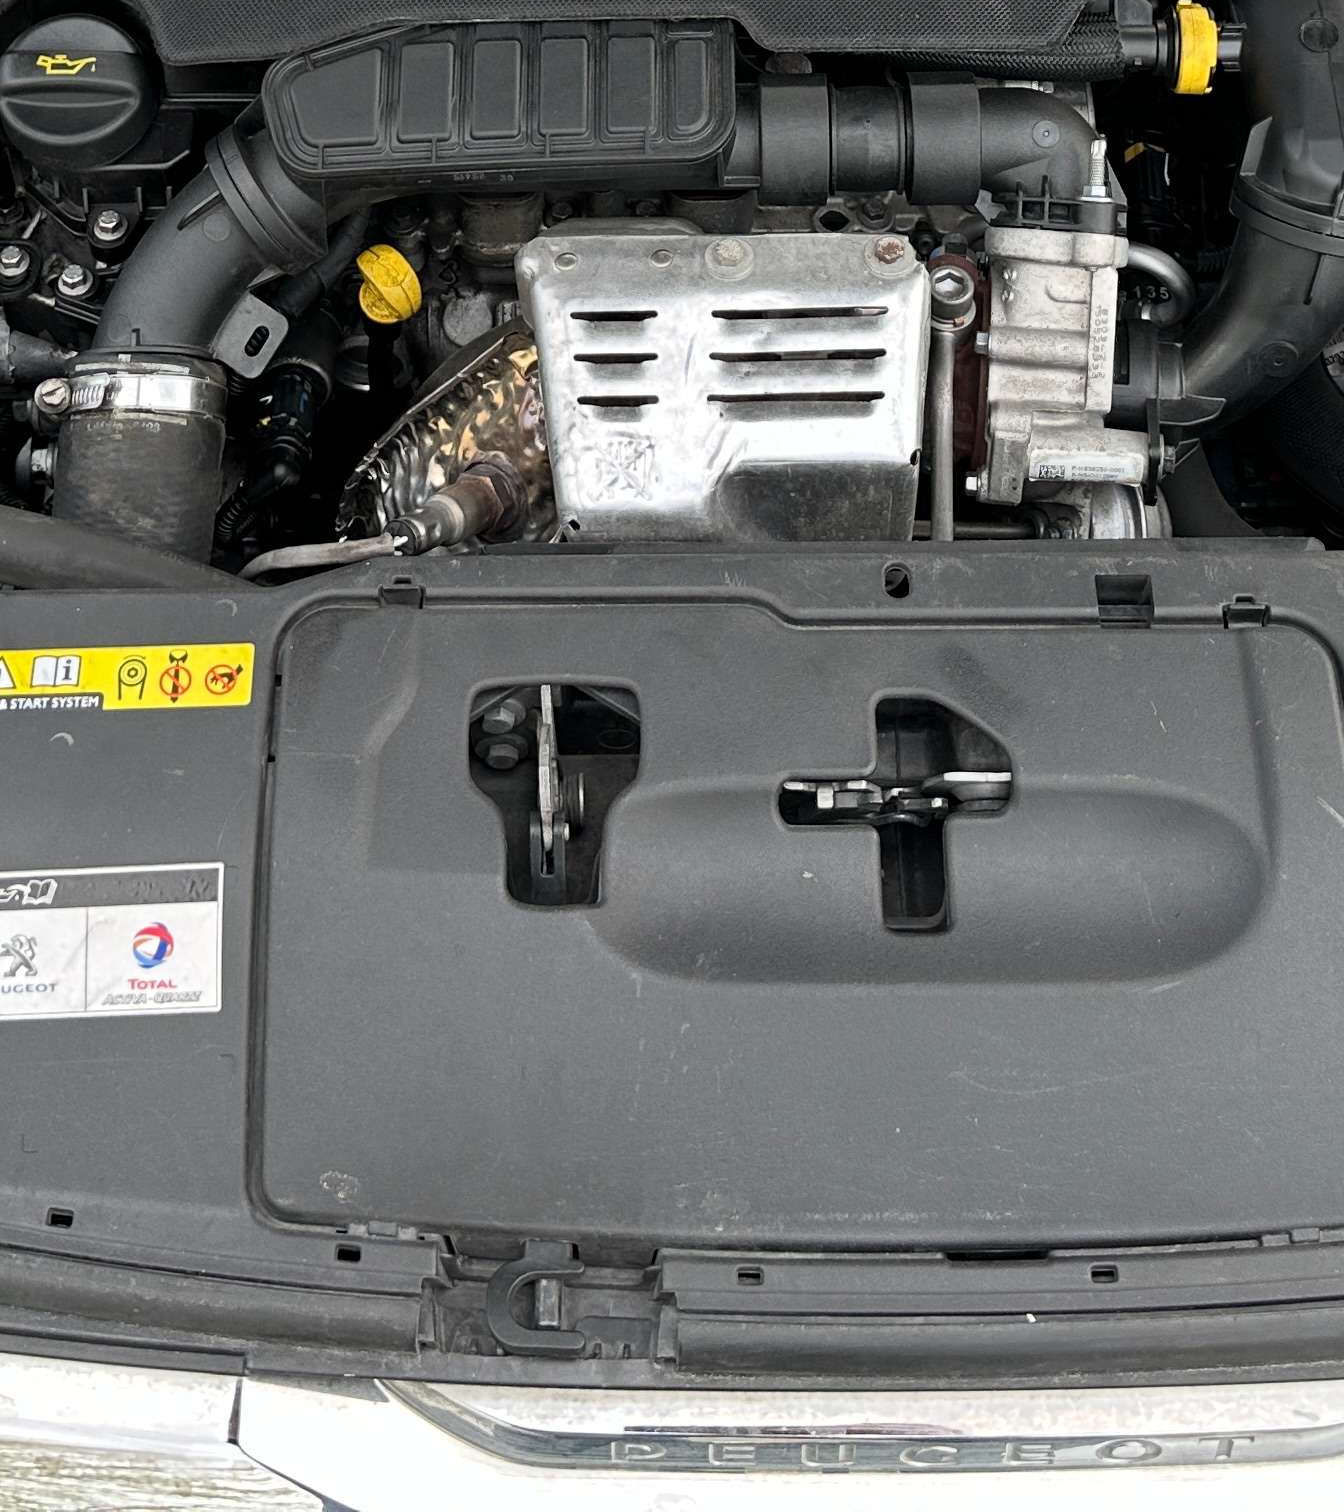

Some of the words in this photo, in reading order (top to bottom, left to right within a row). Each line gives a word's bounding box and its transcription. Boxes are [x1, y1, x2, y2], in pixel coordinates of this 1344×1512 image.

[9, 697, 50, 710] START
[51, 696, 99, 708] SYSTEM
[609, 1435, 1257, 1467] PEUGEOT
